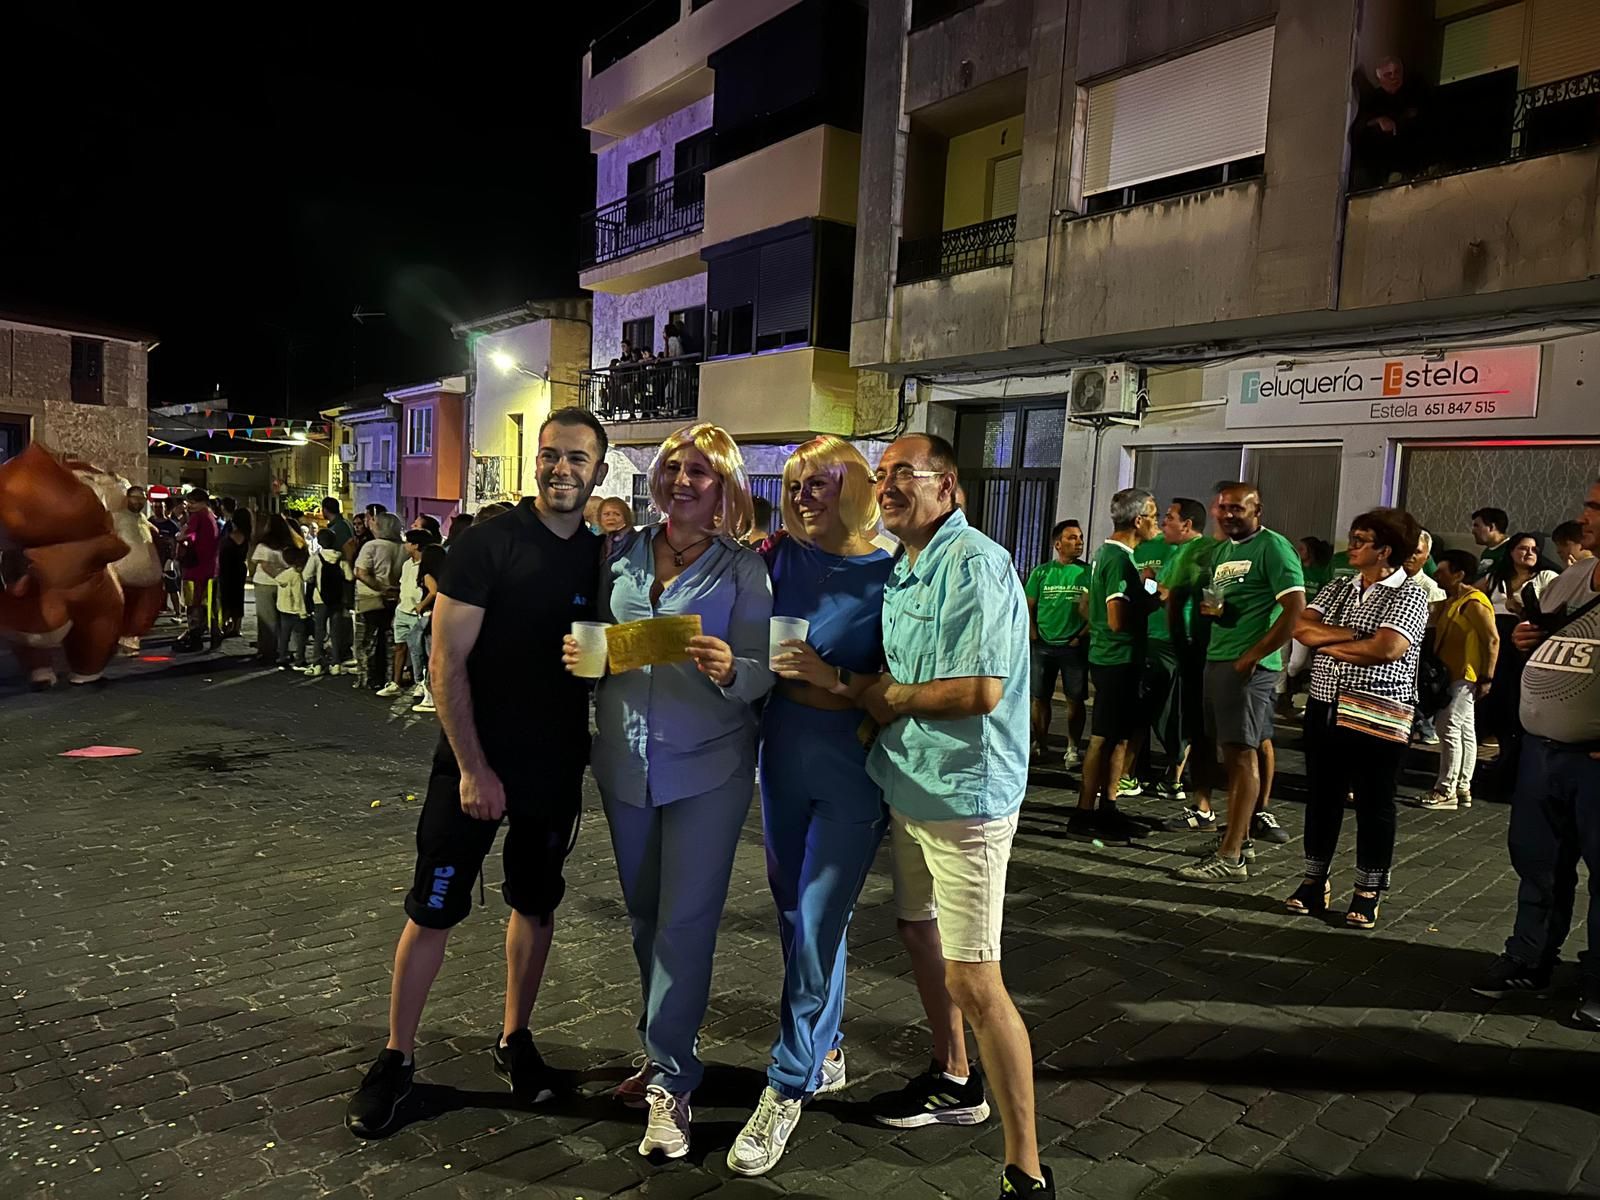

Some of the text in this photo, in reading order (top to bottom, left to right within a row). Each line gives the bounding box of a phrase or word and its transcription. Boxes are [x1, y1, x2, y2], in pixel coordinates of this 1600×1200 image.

[1247, 366, 1363, 400] Peluquería
[1370, 400, 1496, 419] Estela 651 847 515
